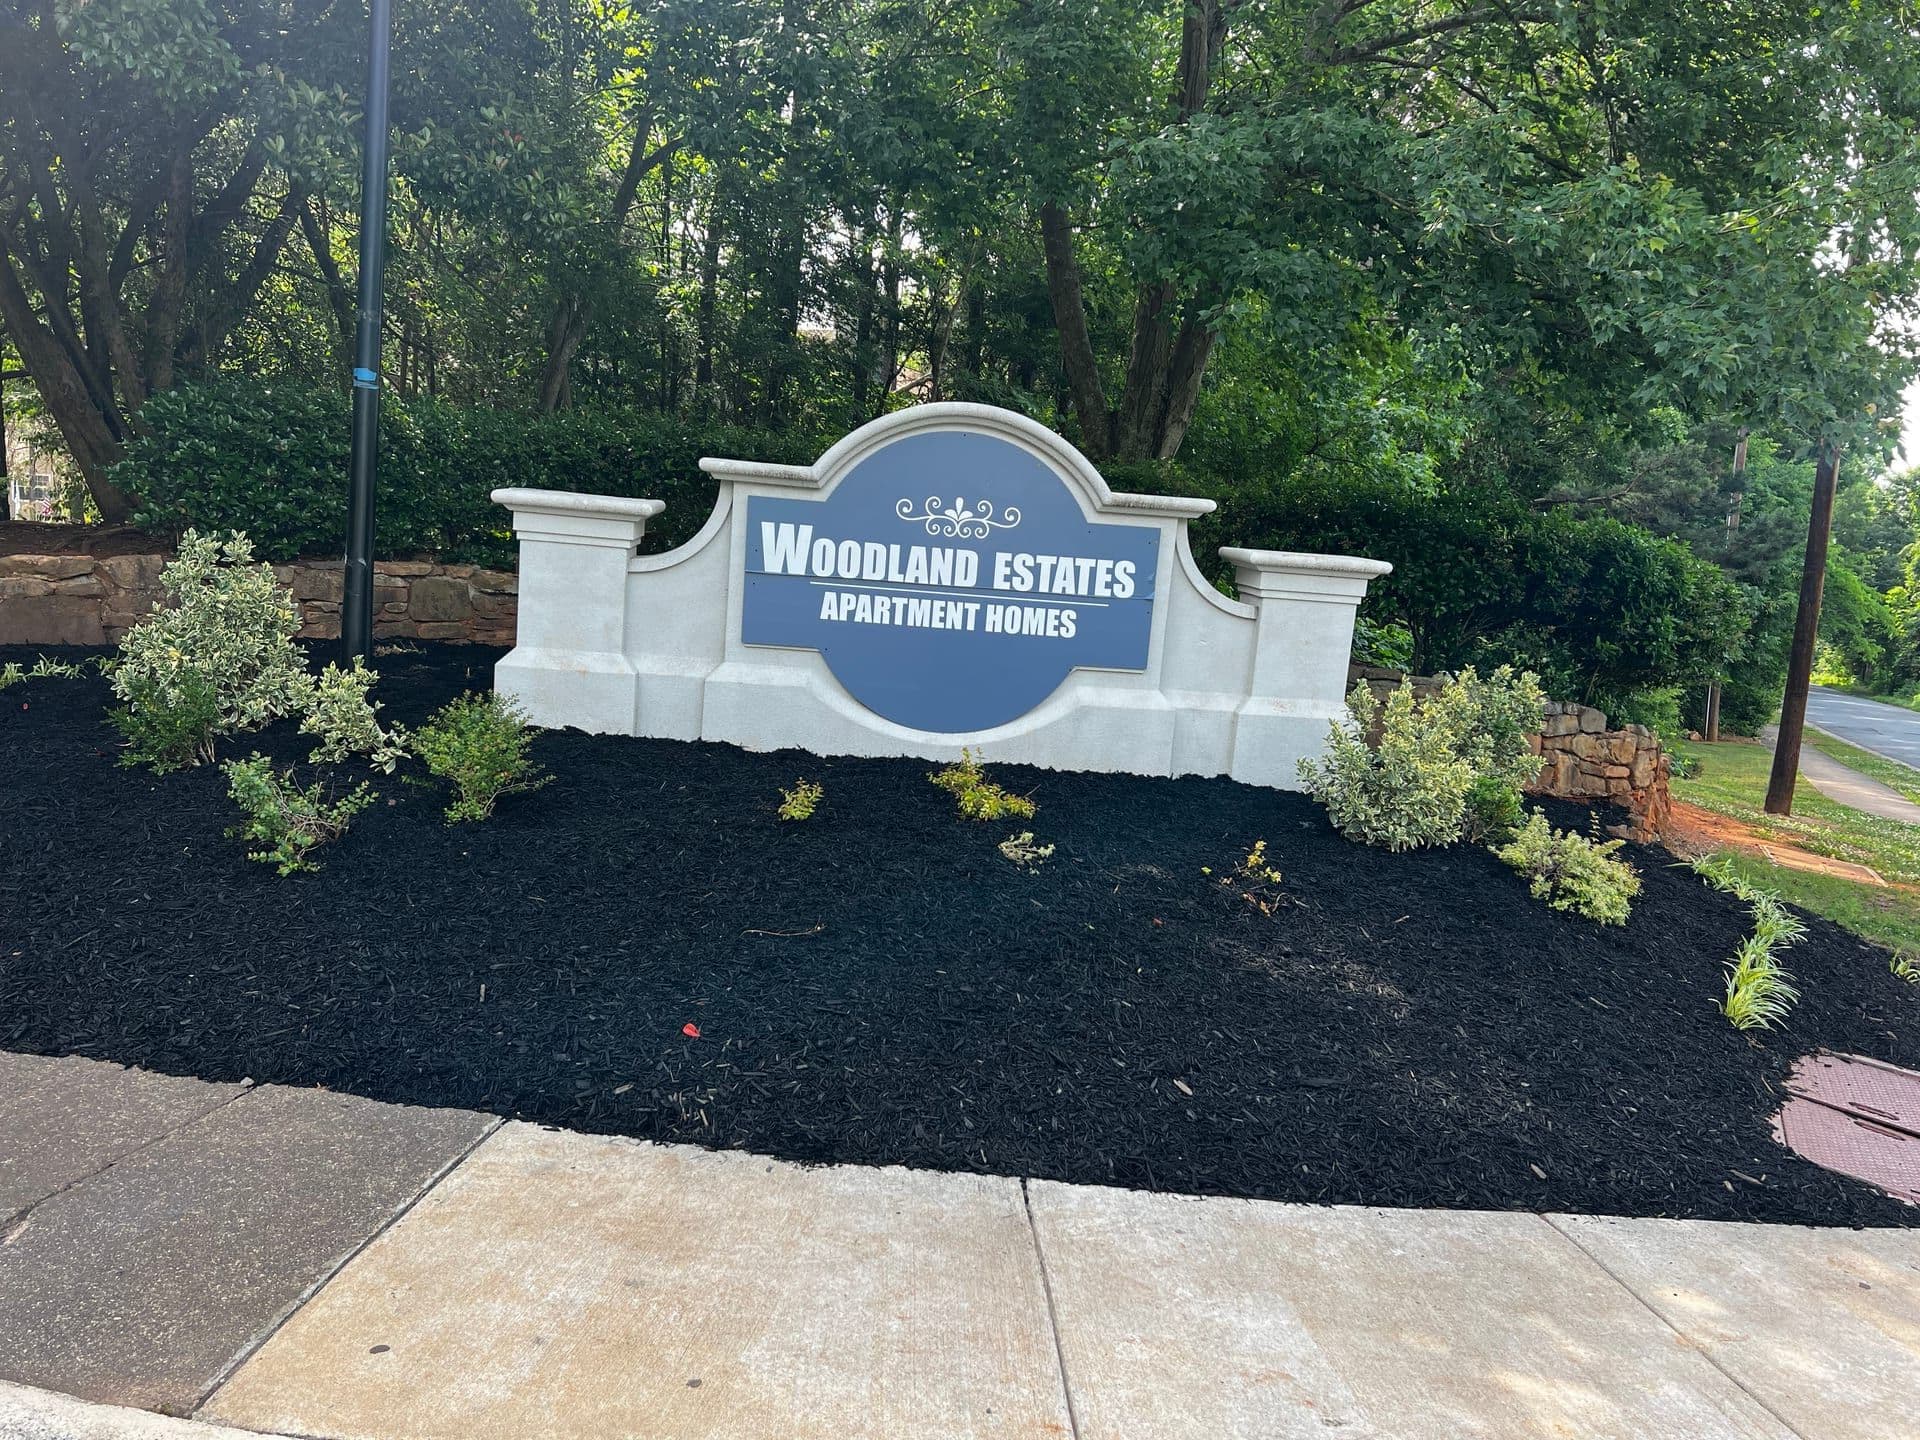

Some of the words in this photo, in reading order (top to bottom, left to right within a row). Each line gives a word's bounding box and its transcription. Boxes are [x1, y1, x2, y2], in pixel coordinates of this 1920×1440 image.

[992, 551, 1136, 599] ESTATES
[819, 591, 981, 632] APARTMENT
[985, 604, 1077, 639] HOMES
